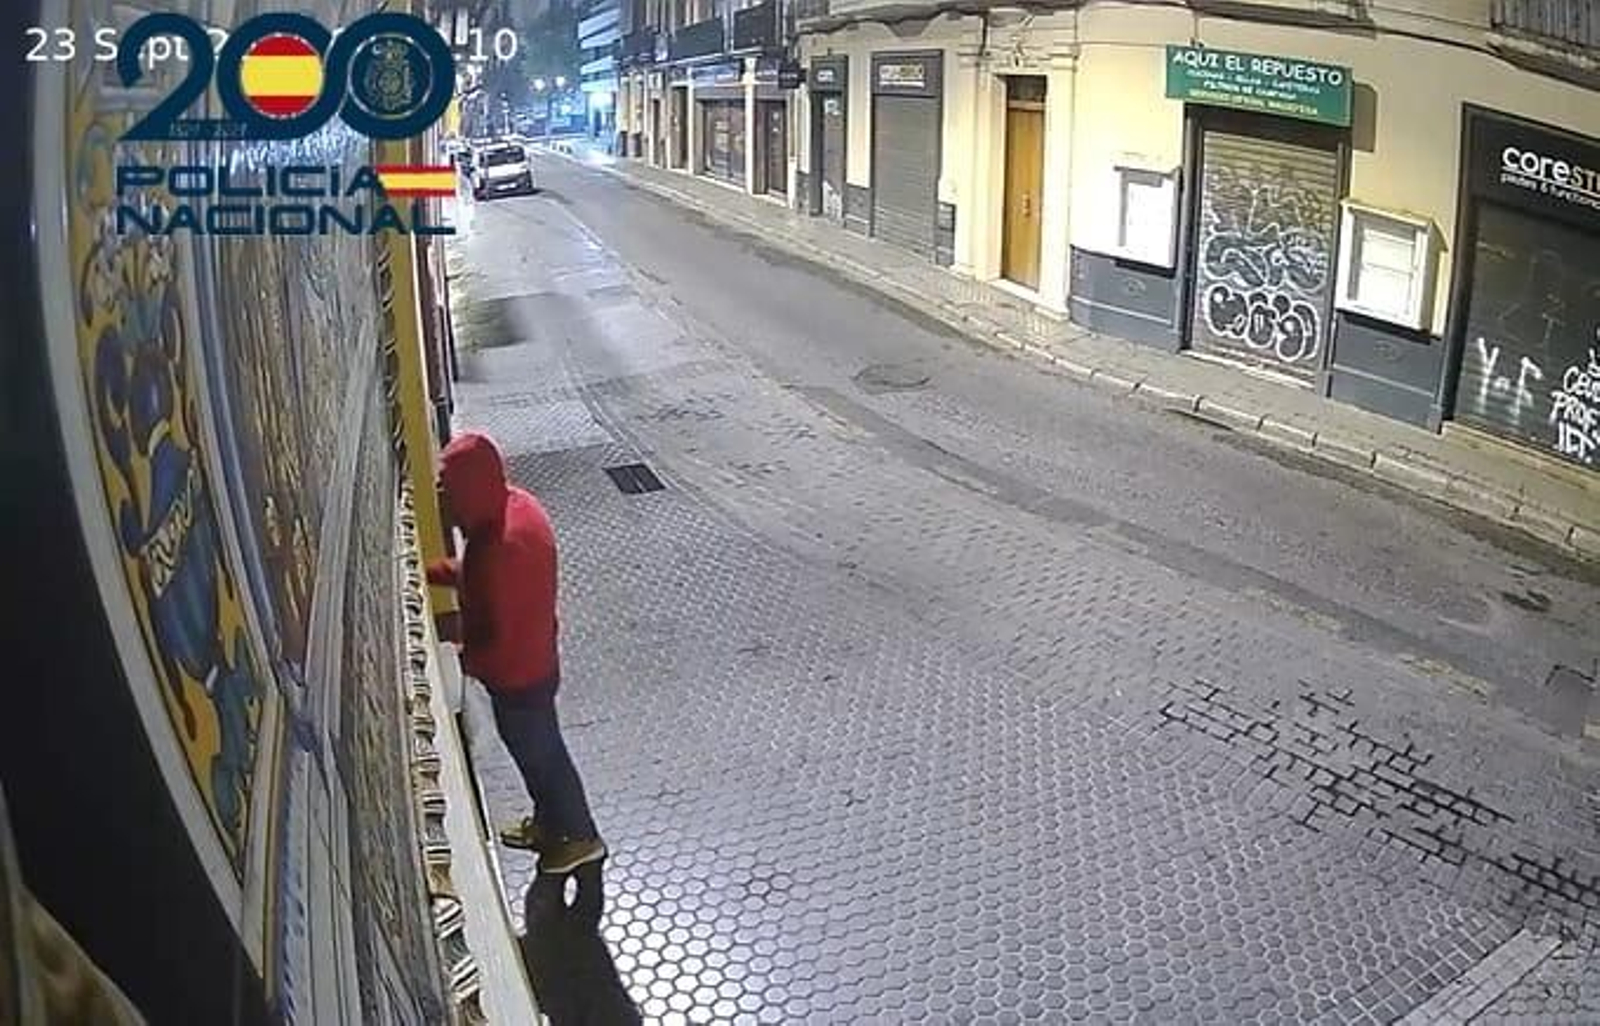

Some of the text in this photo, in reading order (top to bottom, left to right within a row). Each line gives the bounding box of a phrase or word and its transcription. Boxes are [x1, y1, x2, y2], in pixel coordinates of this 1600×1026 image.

[1172, 51, 1342, 85] AQUI EL REPUESTO
